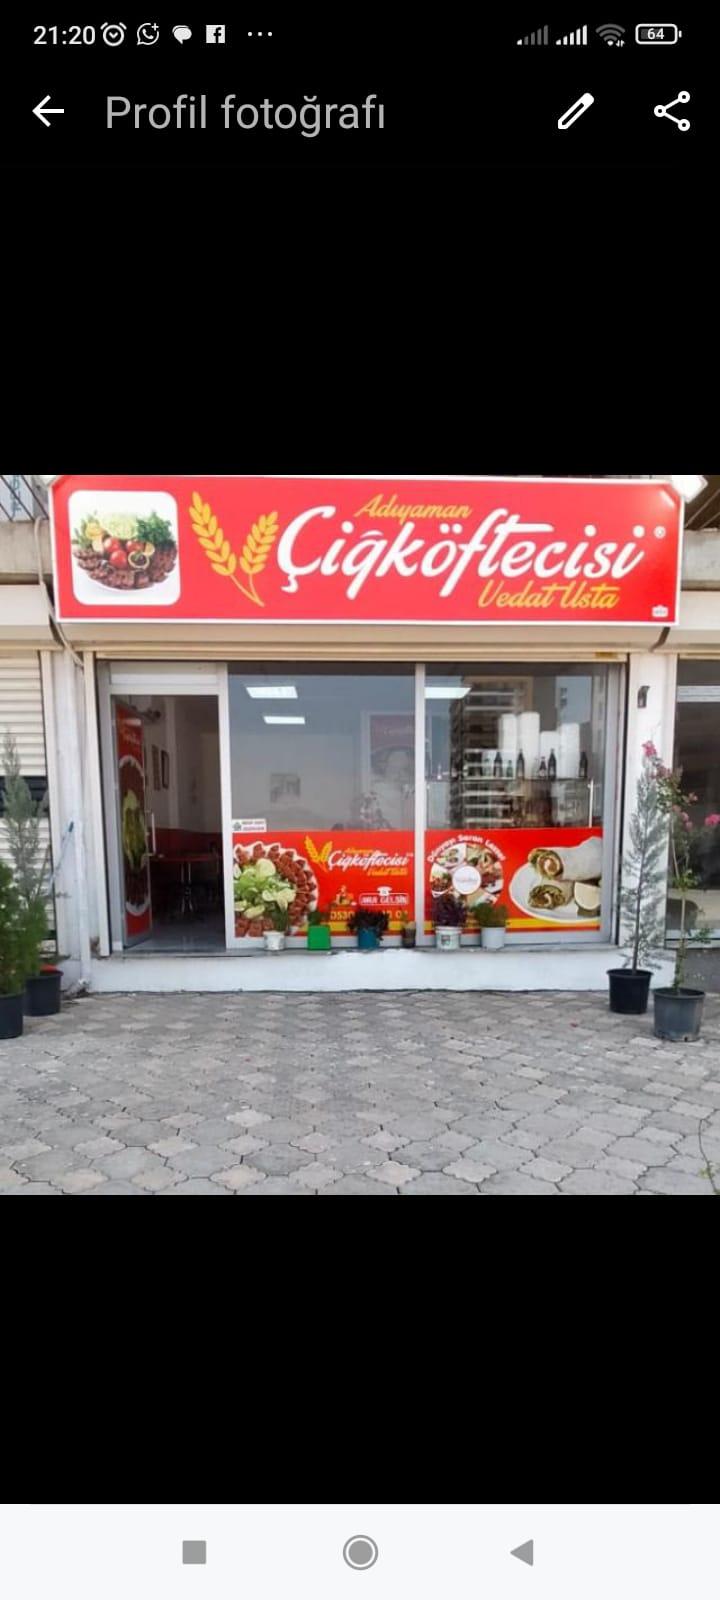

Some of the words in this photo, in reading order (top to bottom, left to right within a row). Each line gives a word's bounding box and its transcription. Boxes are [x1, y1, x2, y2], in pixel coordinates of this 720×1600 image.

[354, 493, 472, 526] Adıyaman
[478, 579, 560, 609] Vedat
[559, 579, 620, 609] Usta
